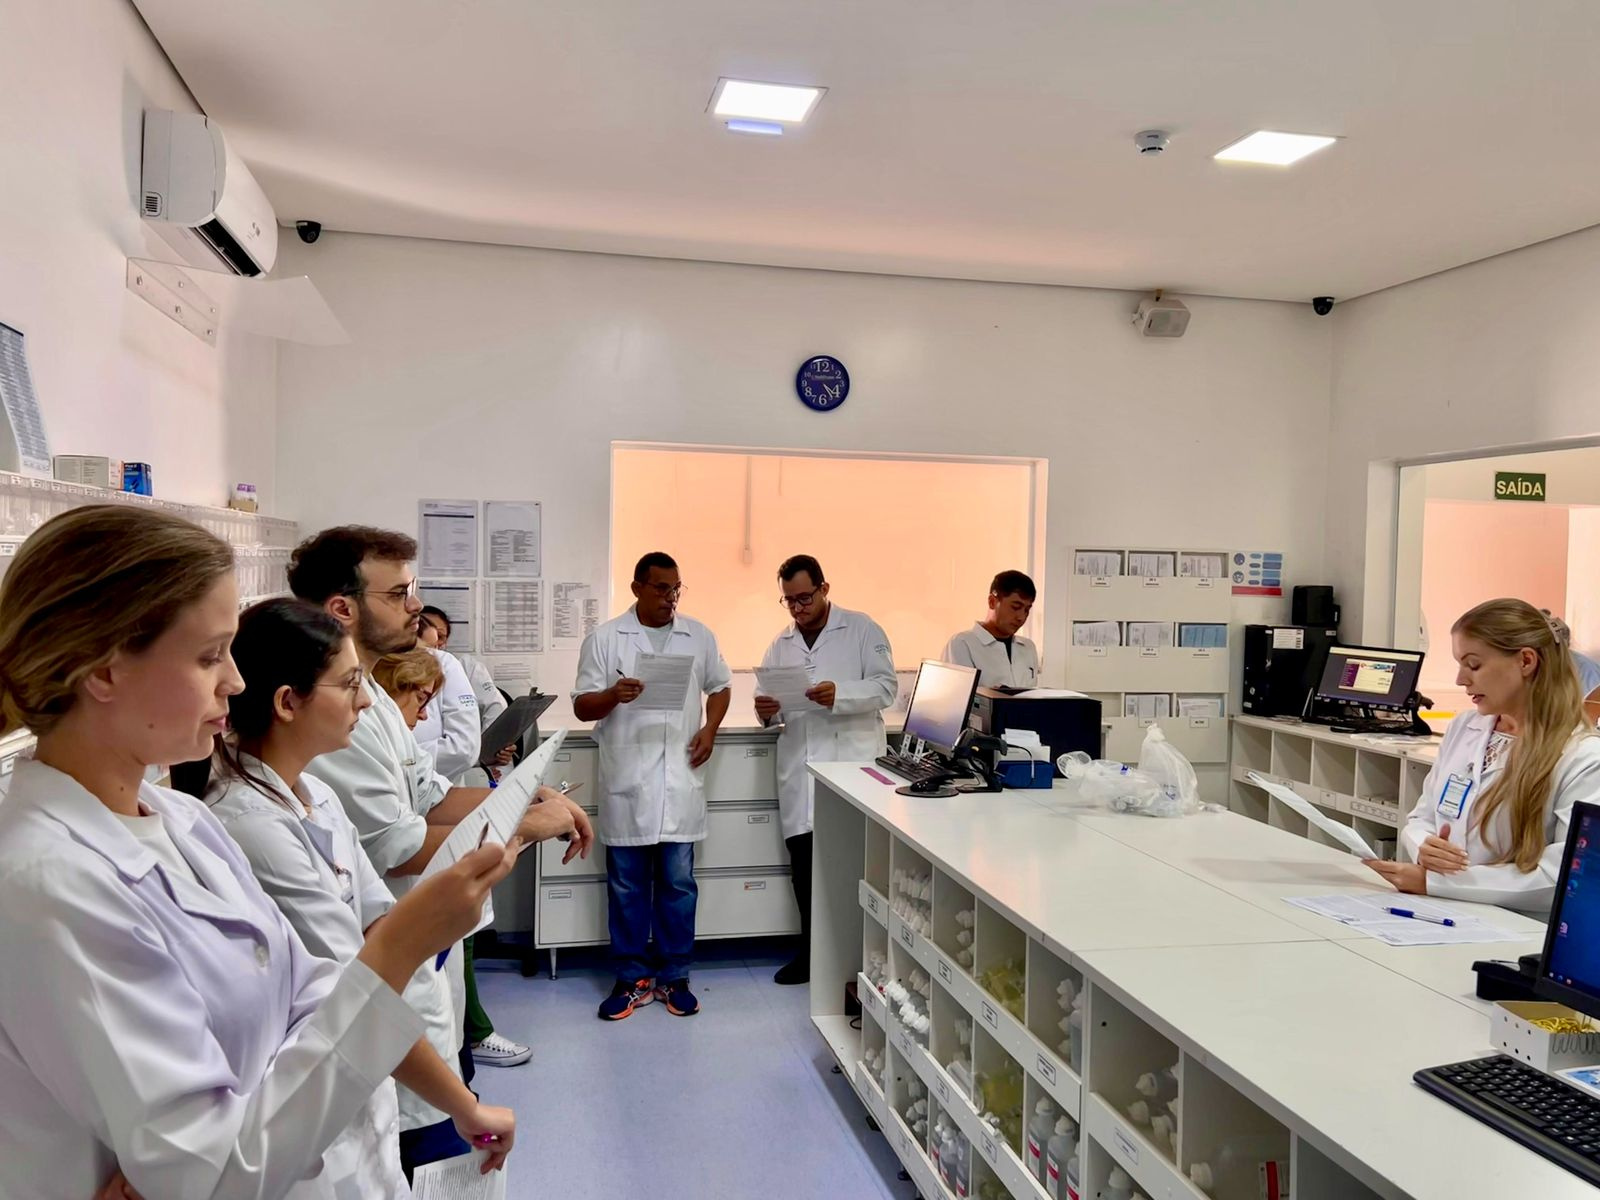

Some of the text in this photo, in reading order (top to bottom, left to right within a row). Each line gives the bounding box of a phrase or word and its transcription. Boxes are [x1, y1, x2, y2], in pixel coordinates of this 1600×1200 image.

[816, 361, 830, 373] 12
[835, 370, 842, 379] 2
[840, 380, 846, 388] 3
[804, 386, 812, 397] 8
[831, 384, 841, 398] 4
[811, 394, 817, 402] 7
[819, 394, 827, 405] 6
[1496, 477, 1544, 496] SAÍDA
